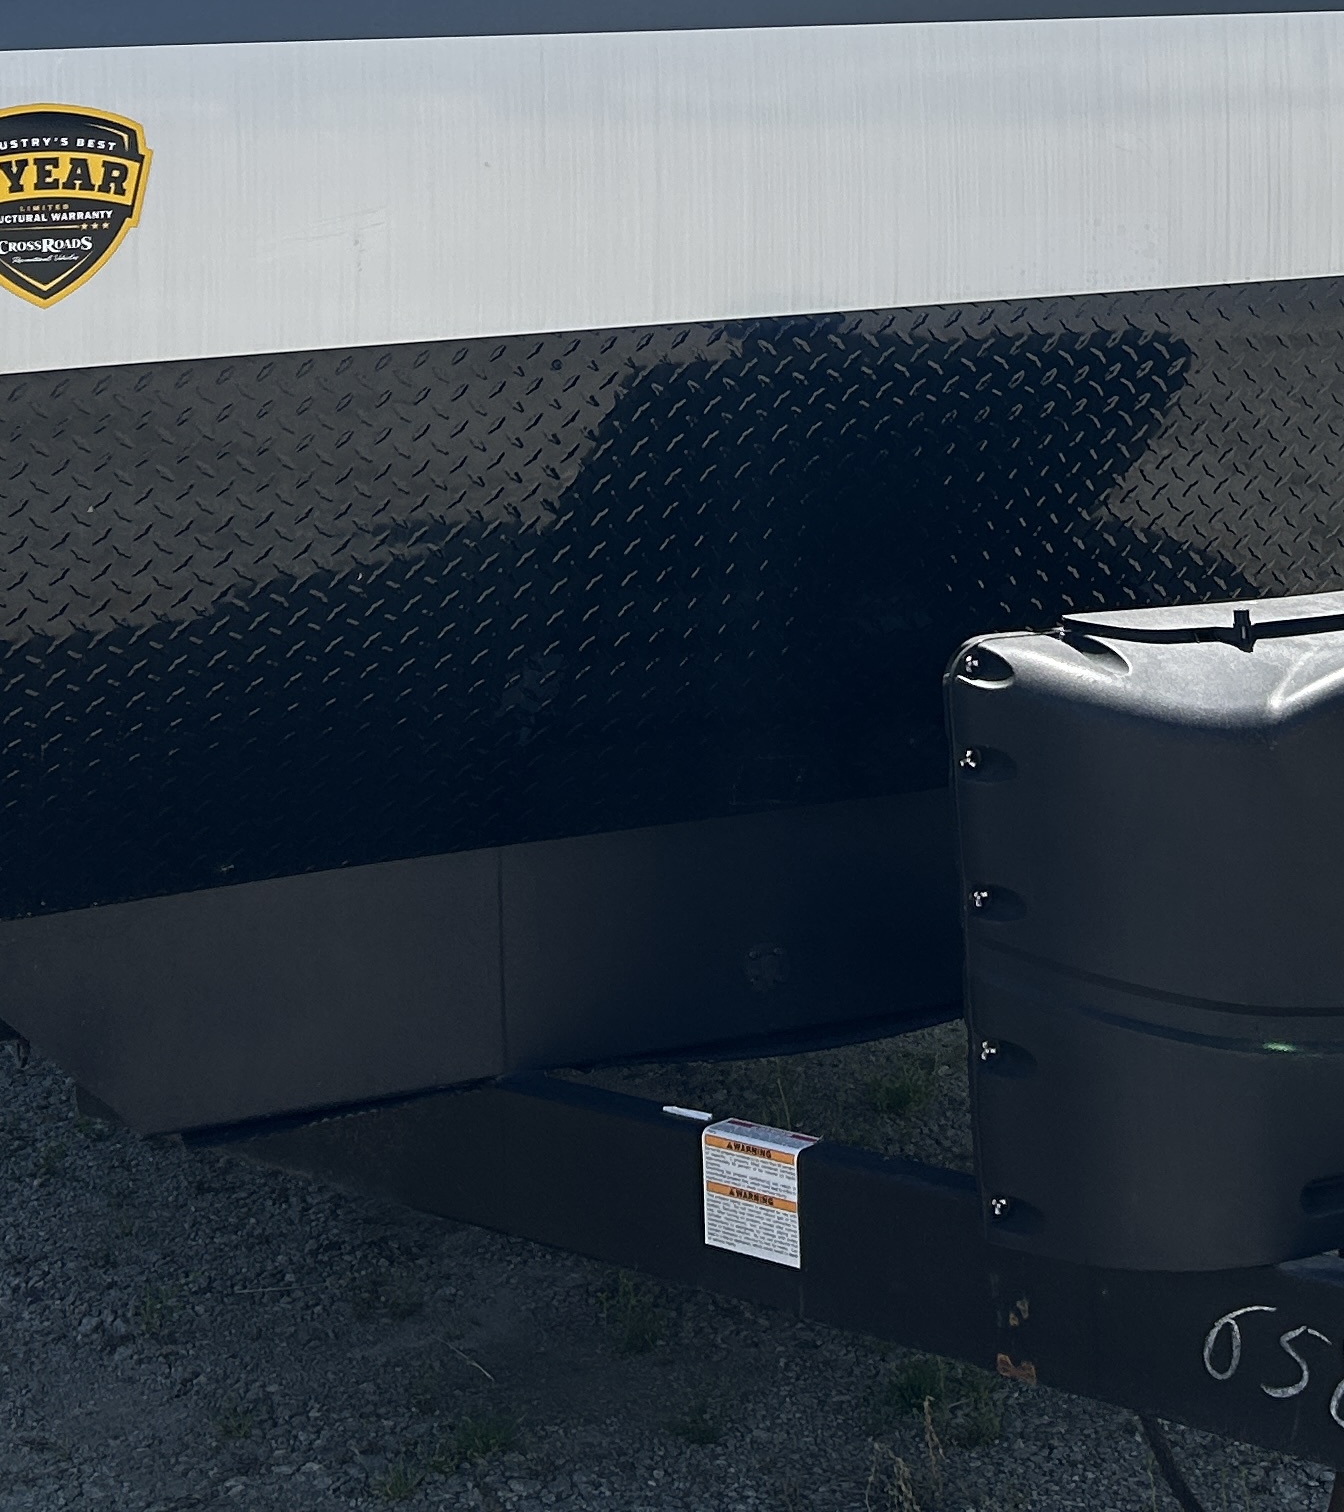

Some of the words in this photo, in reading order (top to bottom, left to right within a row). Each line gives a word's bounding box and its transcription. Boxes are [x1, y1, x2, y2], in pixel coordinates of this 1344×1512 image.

[76, 137, 117, 151] BEST
[0, 158, 129, 196] YEAR
[19, 203, 70, 212] LIMITED
[51, 210, 113, 222] WARRANTY
[734, 1143, 772, 1159] WARNING
[736, 1189, 774, 1206] WARNING
